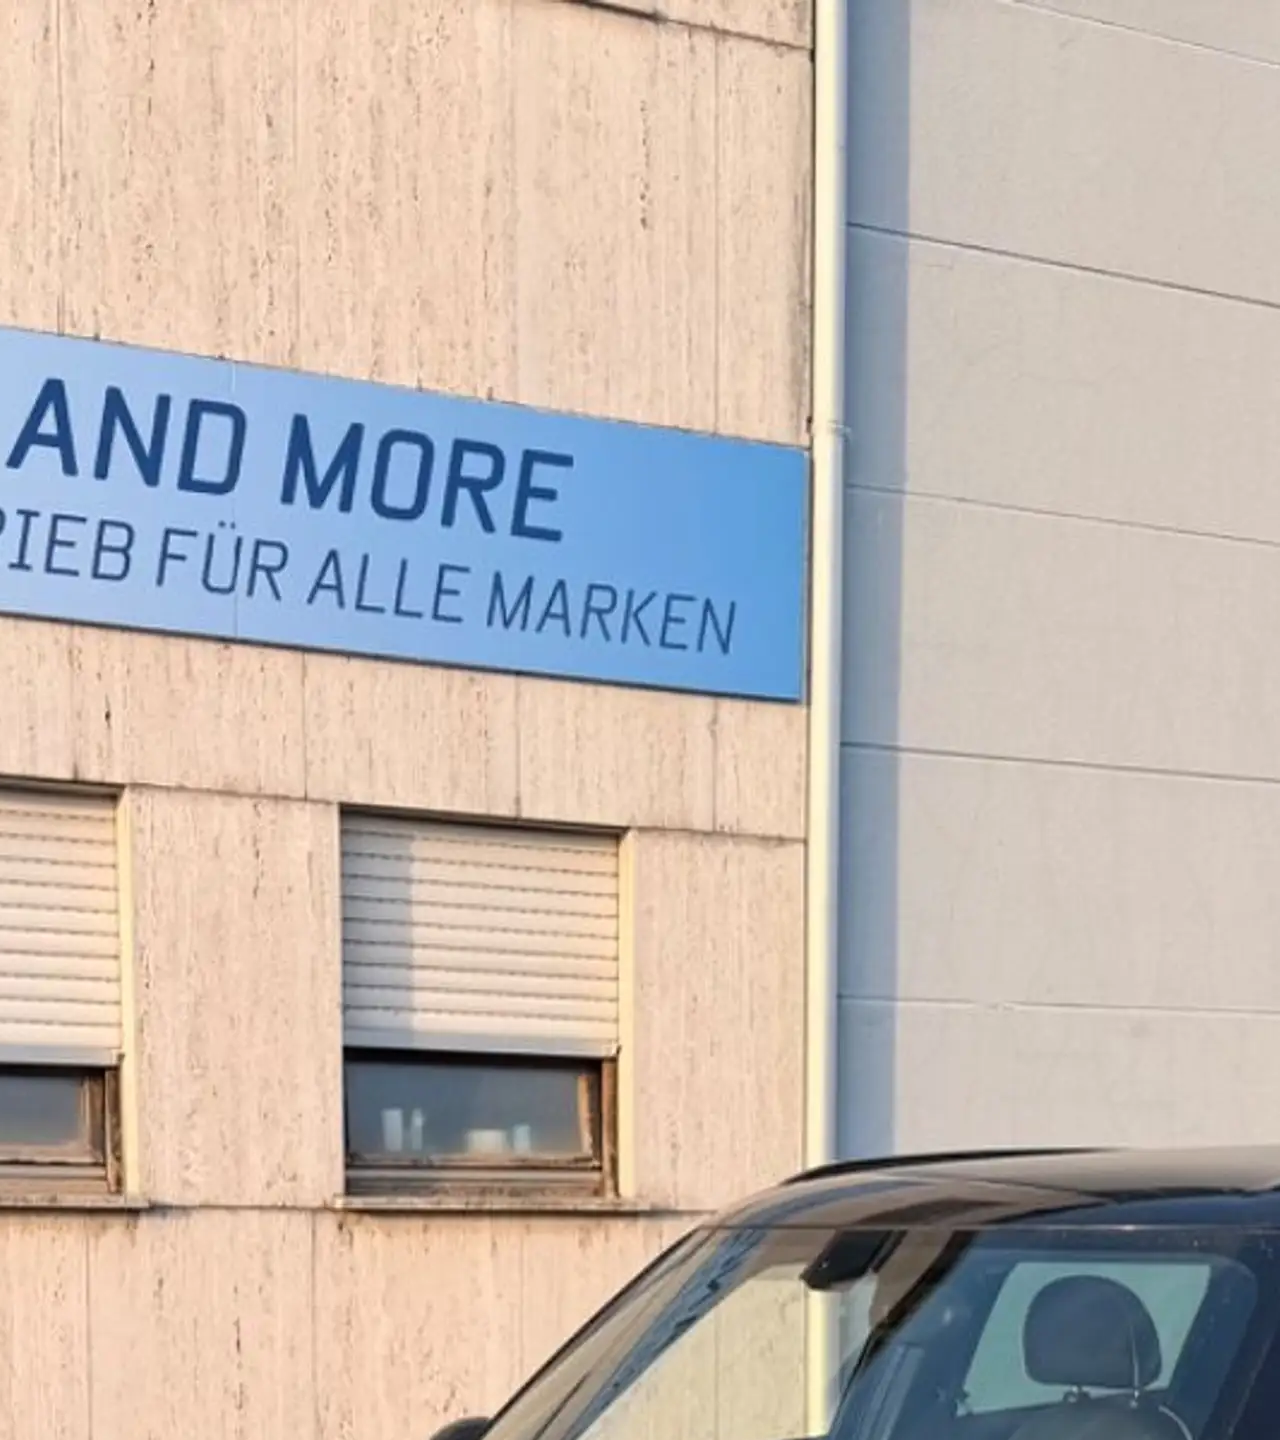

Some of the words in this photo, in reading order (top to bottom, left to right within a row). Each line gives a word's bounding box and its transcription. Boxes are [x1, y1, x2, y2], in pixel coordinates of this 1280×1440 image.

[4, 377, 248, 497] AND
[279, 412, 574, 543] MORE
[156, 522, 289, 602] FÜR
[306, 548, 471, 624] ALLE
[486, 570, 736, 655] MARKEN
